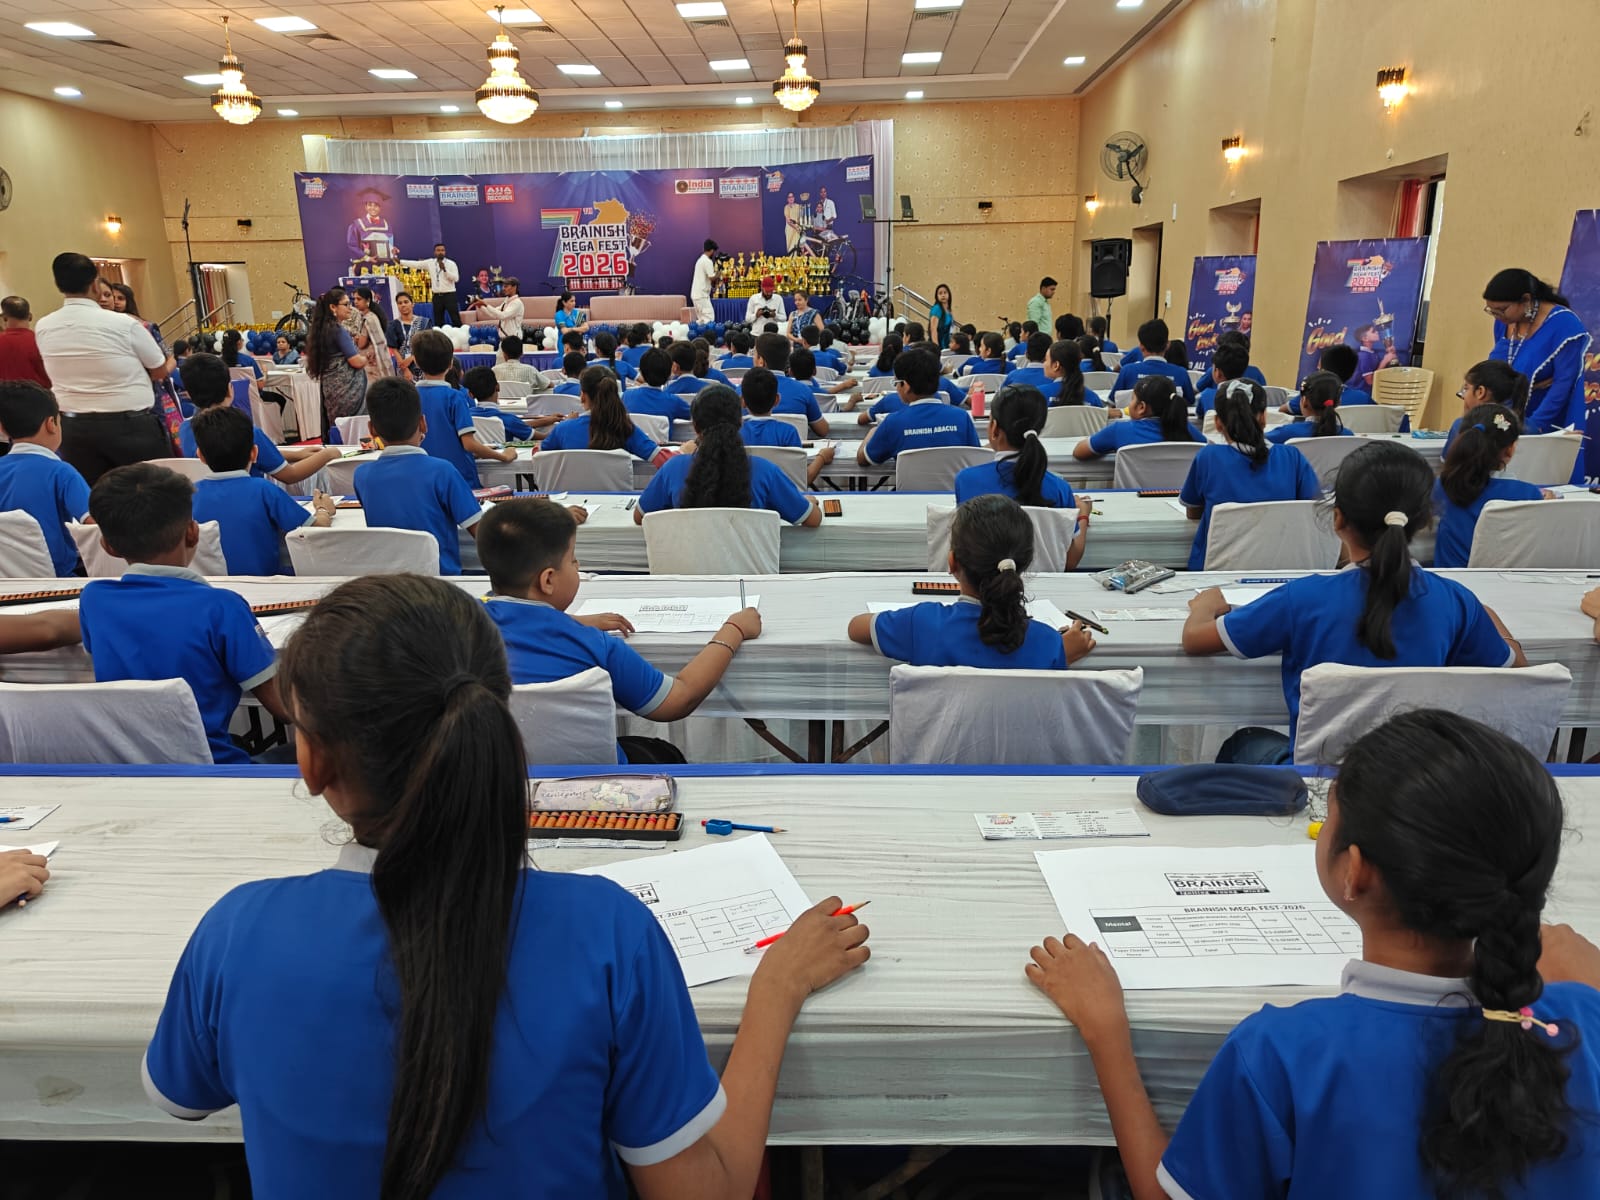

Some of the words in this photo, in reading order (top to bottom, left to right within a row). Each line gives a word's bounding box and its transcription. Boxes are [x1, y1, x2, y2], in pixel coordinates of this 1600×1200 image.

[721, 184, 757, 192] BRAINISH
[560, 225, 626, 240] BRAINISH
[562, 241, 595, 252] MEGA
[598, 240, 626, 251] FEST
[563, 253, 628, 276] 2026
[1352, 277, 1379, 287] 2026
[1188, 319, 1217, 340] Good
[1306, 326, 1348, 355] Good
[903, 427, 933, 436] BRAINISH
[933, 425, 958, 433] ABACUS
[1173, 879, 1260, 888] BRAINISH
[667, 909, 688, 918] 2026
